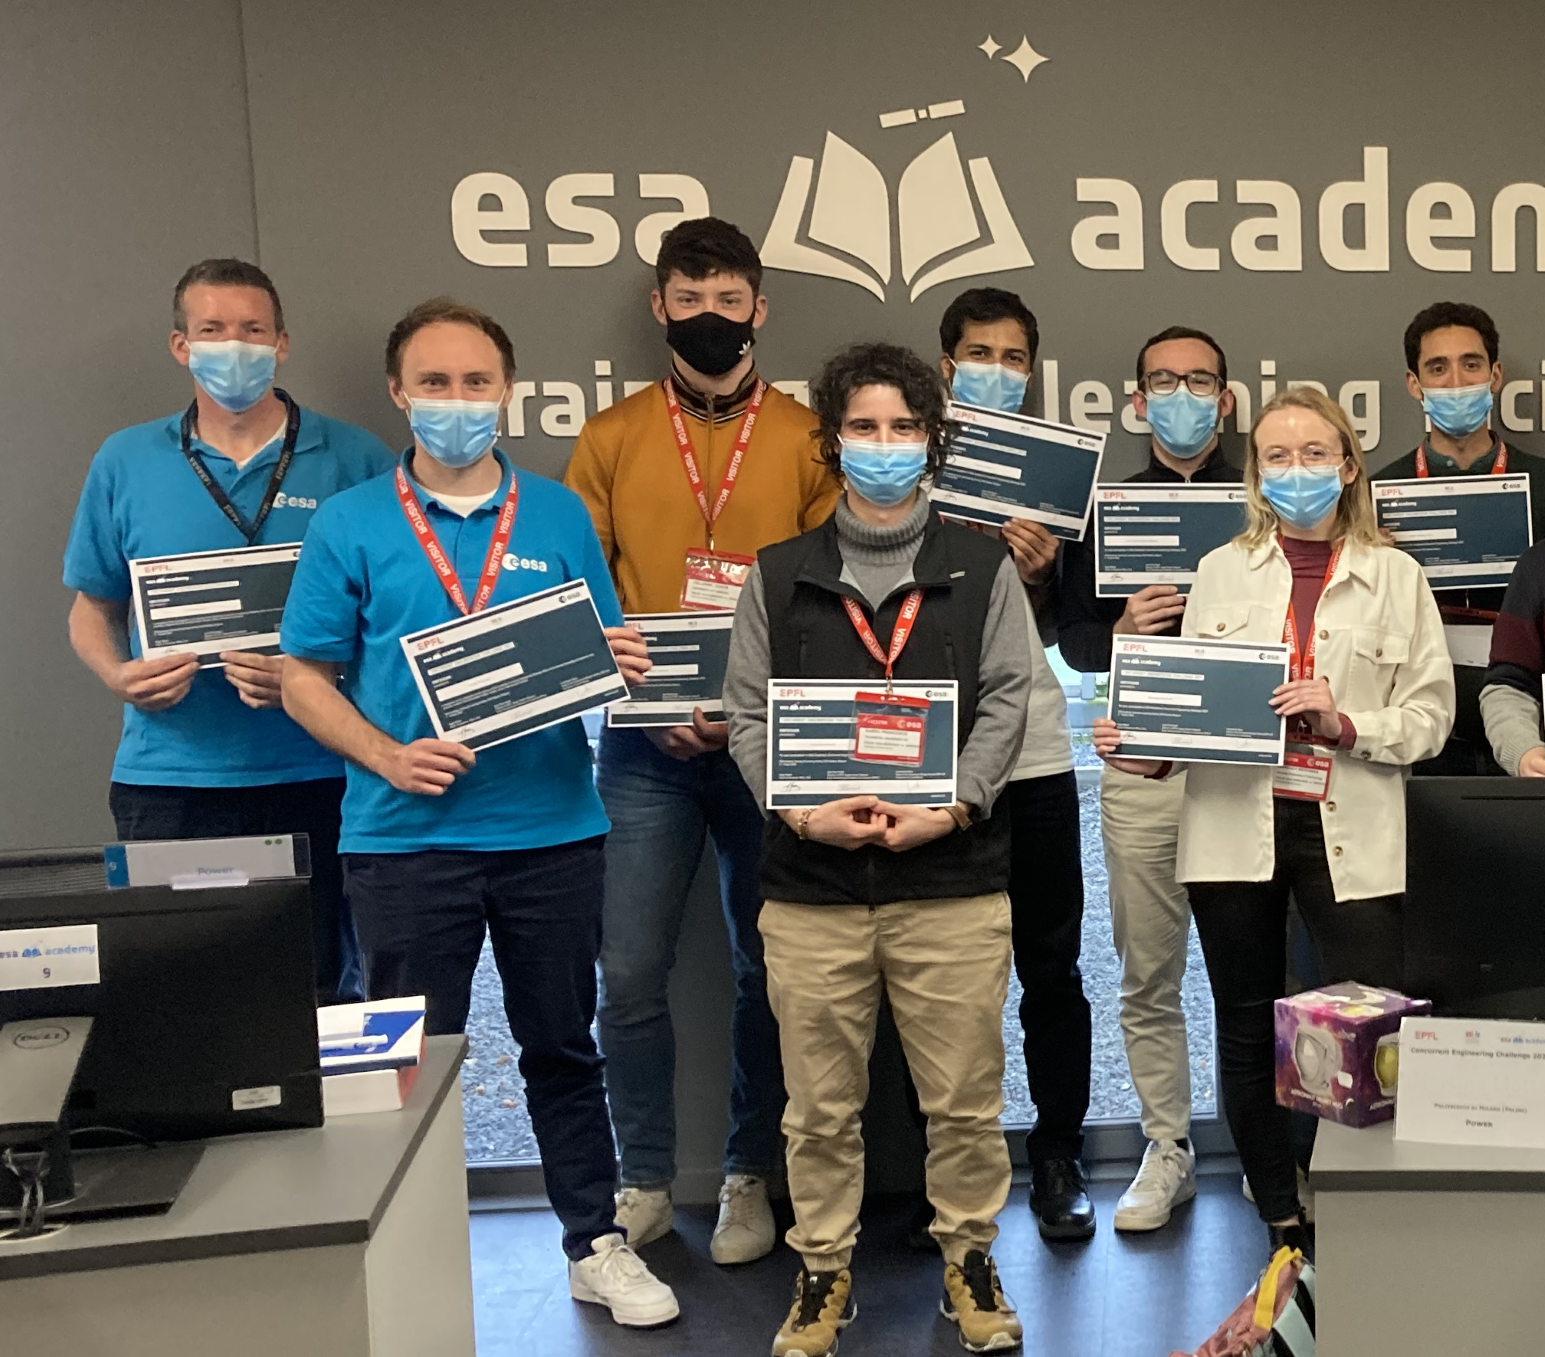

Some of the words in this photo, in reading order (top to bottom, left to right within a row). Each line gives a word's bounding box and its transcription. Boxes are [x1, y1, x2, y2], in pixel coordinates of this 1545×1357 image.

[451, 171, 710, 267] esa
[673, 413, 688, 446] VISITOR
[739, 413, 757, 443] VISITOR
[684, 452, 700, 484] VISITOR
[726, 450, 743, 481] VISITOR
[1381, 488, 1404, 497] EPFL
[288, 496, 317, 509] esa
[405, 499, 428, 535] VISITOR
[499, 501, 515, 534] VISITOR
[427, 541, 451, 577] VISITOR
[486, 541, 505, 577] VISITOR
[520, 558, 547, 572] esa
[417, 637, 445, 651] EPFL
[1123, 643, 1148, 652] EPFL
[780, 689, 807, 697] EPFL
[44, 944, 96, 956] academy
[42, 967, 51, 979] 9
[1415, 1031, 1439, 1041] EPFL
[1411, 1047, 1450, 1055] Concurrent
[1451, 1049, 1494, 1059] Engineering
[1496, 1051, 1531, 1060] Challenge
